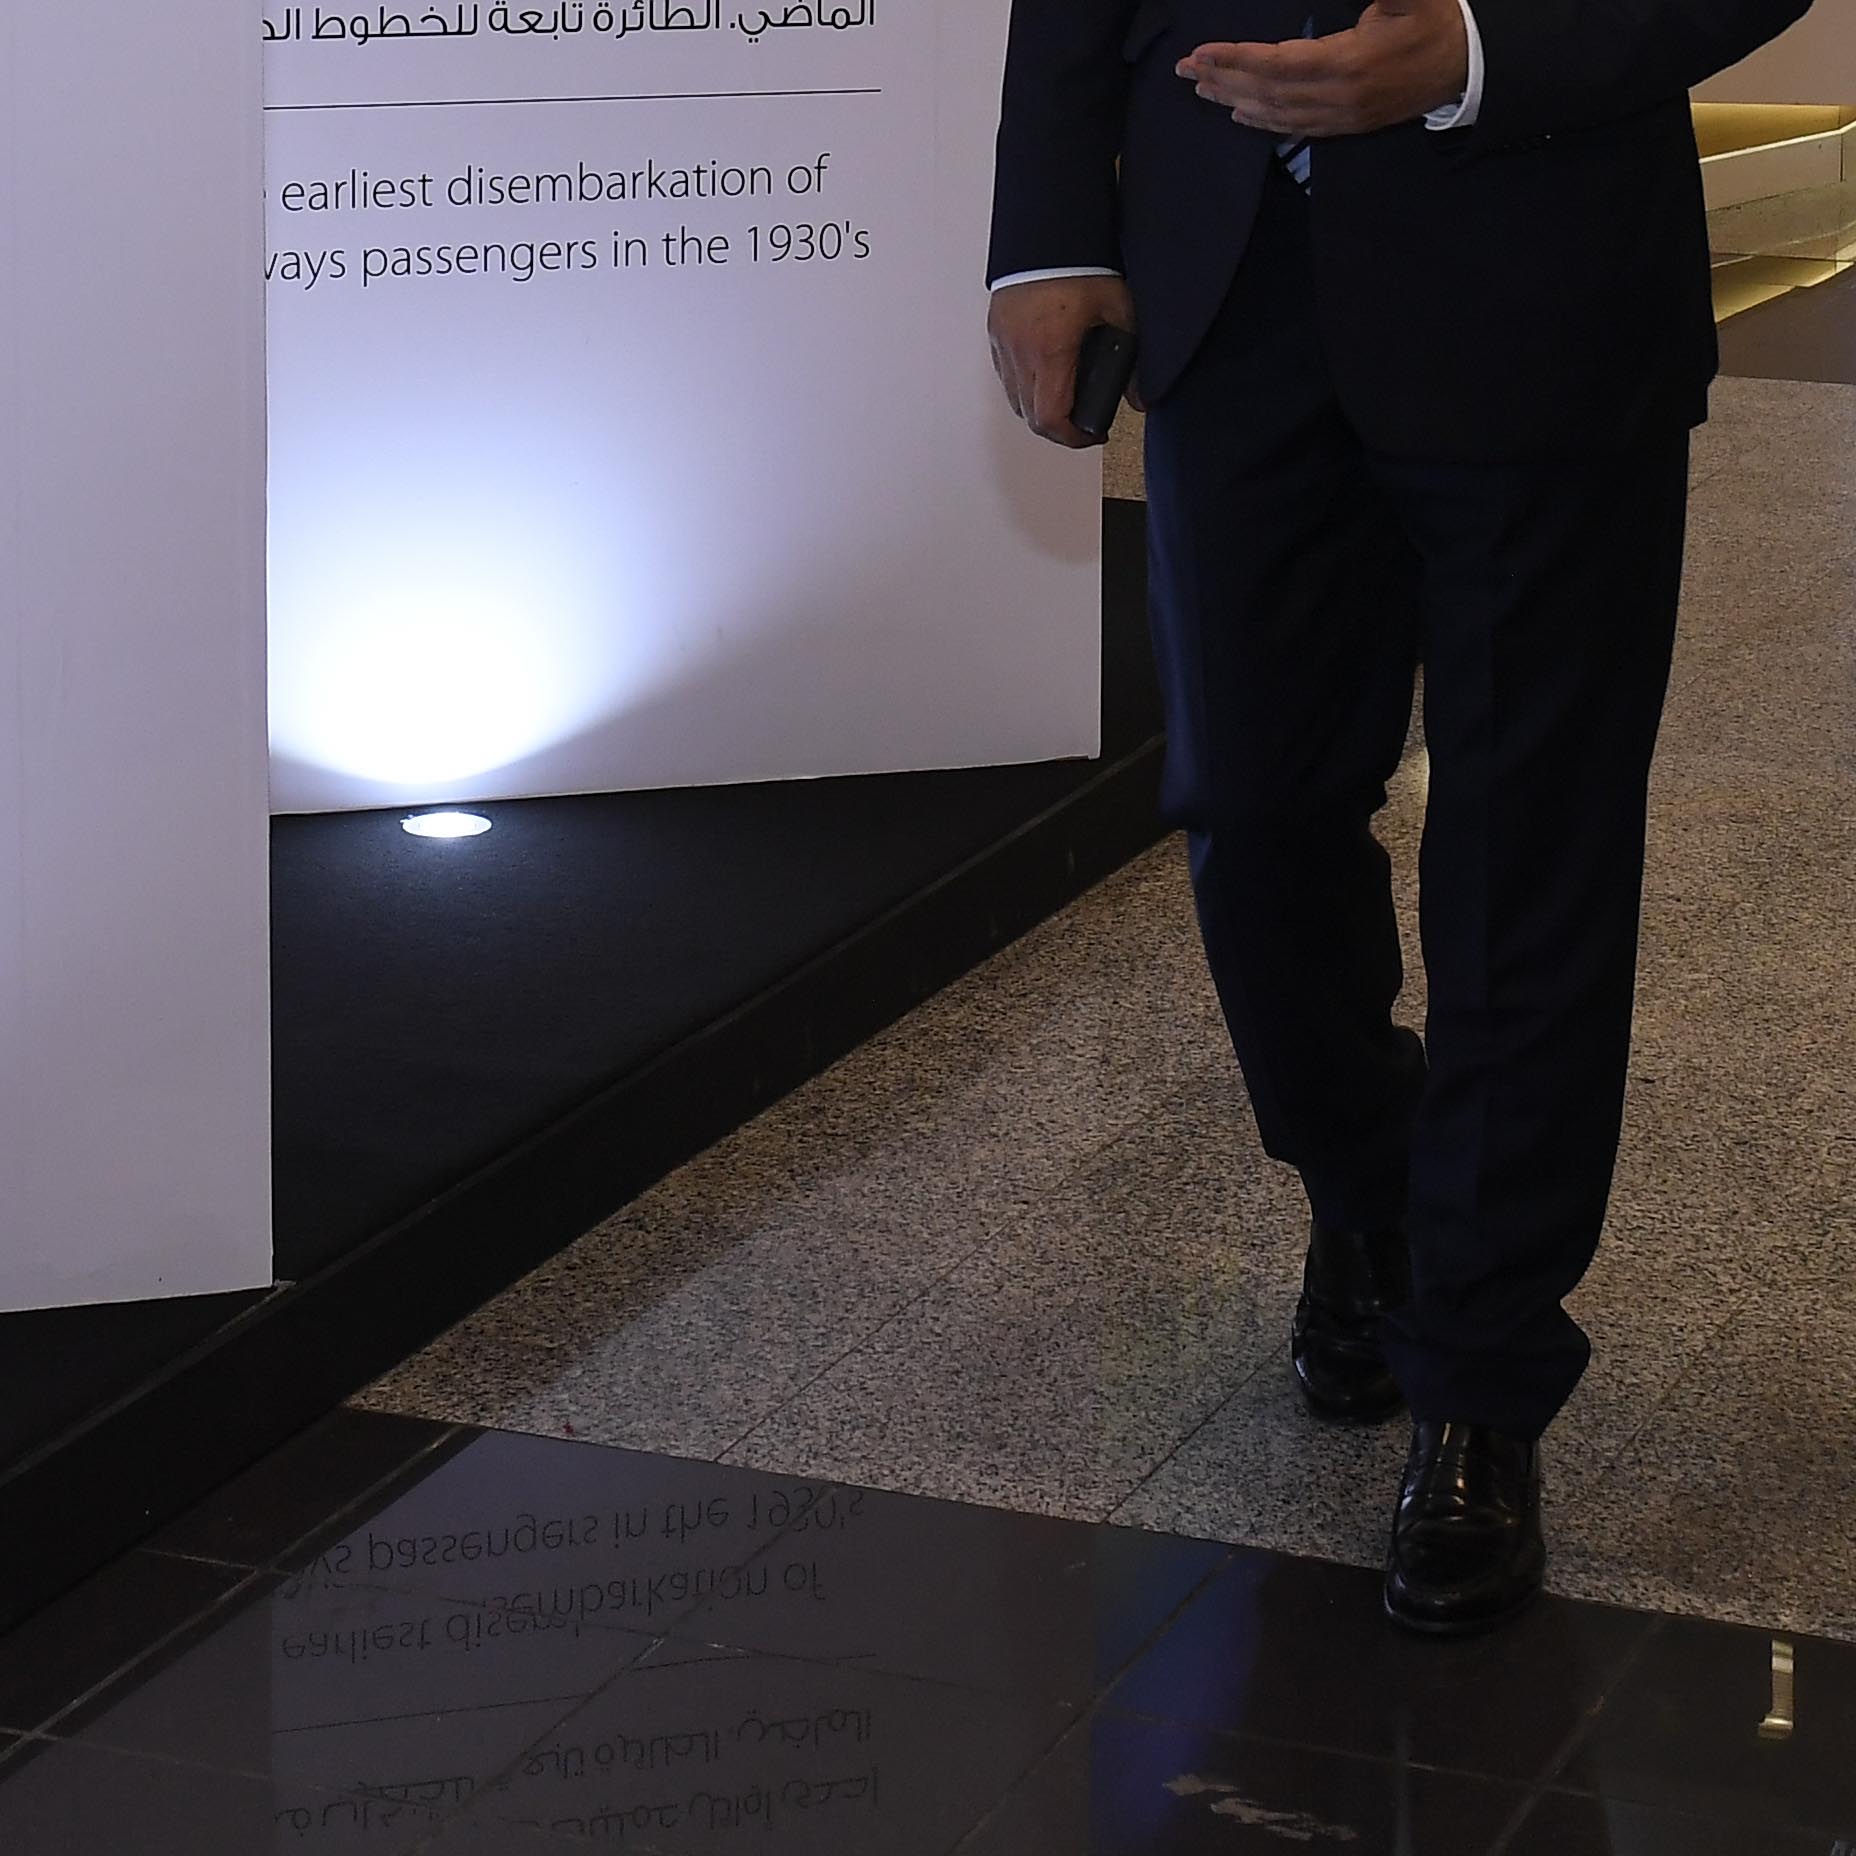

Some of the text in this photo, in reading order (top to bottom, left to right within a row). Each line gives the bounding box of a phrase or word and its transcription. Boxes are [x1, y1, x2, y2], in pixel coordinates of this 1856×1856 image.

[311, 3, 478, 46] للخطوط
[488, 0, 583, 41] تابعة
[281, 152, 831, 212] earliest disembarkation of
[363, 240, 597, 288] passengers
[613, 230, 647, 268] in
[661, 225, 730, 266] the
[747, 220, 870, 262] 1930's
